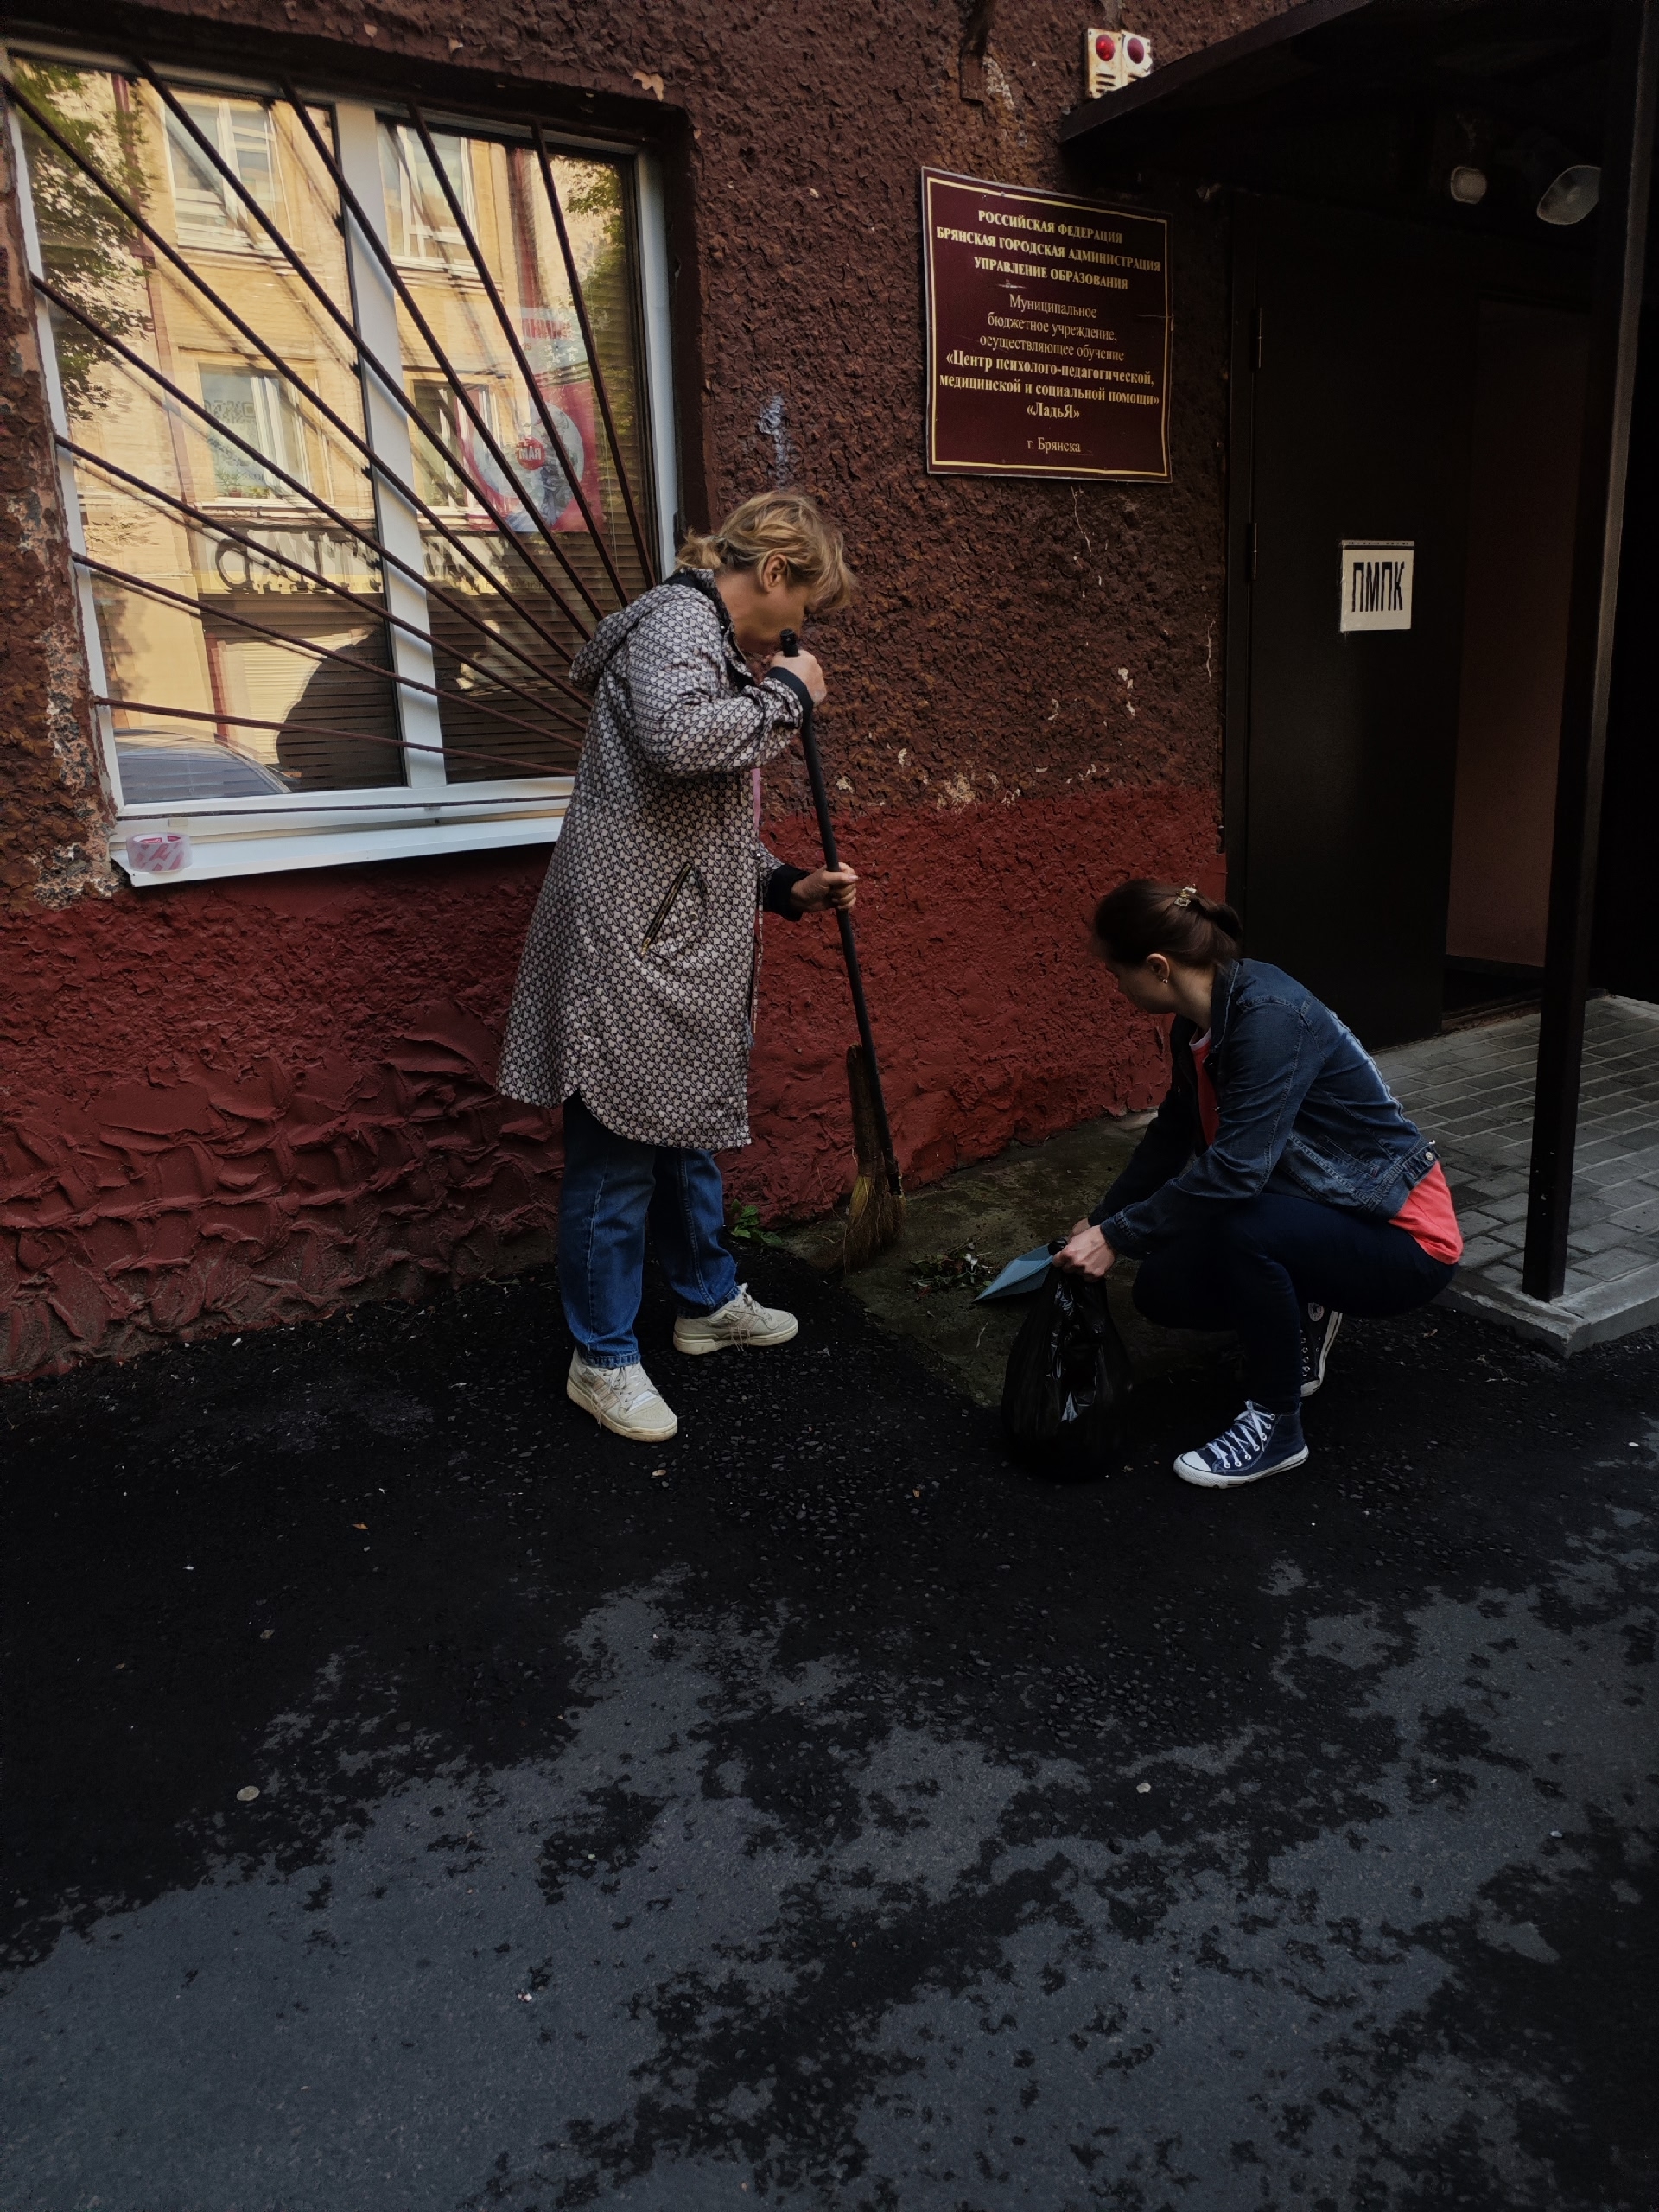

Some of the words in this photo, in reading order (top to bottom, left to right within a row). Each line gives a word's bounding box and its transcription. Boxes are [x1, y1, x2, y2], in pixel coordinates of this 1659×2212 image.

[978, 210, 1055, 233] РОССИЙСКАЯ
[1058, 224, 1122, 244] ФЕДЕРАЦИЯ
[936, 226, 996, 247] БРЯНСКАЯ
[999, 237, 1065, 258] ГОРОДСКАЯ
[1068, 248, 1161, 272] АДМИНИСТРАЦИЯ
[974, 257, 1047, 279] УПРАВЛЕНИЕ
[1050, 268, 1128, 289] ОБРАЗОВАНИЯ
[1009, 294, 1097, 318] Муниципальное
[988, 312, 1049, 332] бюджетное
[1052, 323, 1118, 342] учреждение,
[979, 335, 1075, 356] осуществляющее
[1077, 345, 1125, 362] обучение
[946, 349, 993, 371] «Центр
[996, 359, 1154, 387] психолого-педагогической,
[939, 374, 1021, 394] медицинской
[1025, 384, 1033, 394] и
[1035, 384, 1105, 402] социальной
[1109, 391, 1160, 406] помощи»
[1027, 402, 1080, 419] «ЛадьЯ»
[1027, 440, 1034, 449] г.
[1038, 436, 1081, 454] Брянска
[1351, 561, 1405, 612] ПМПК
